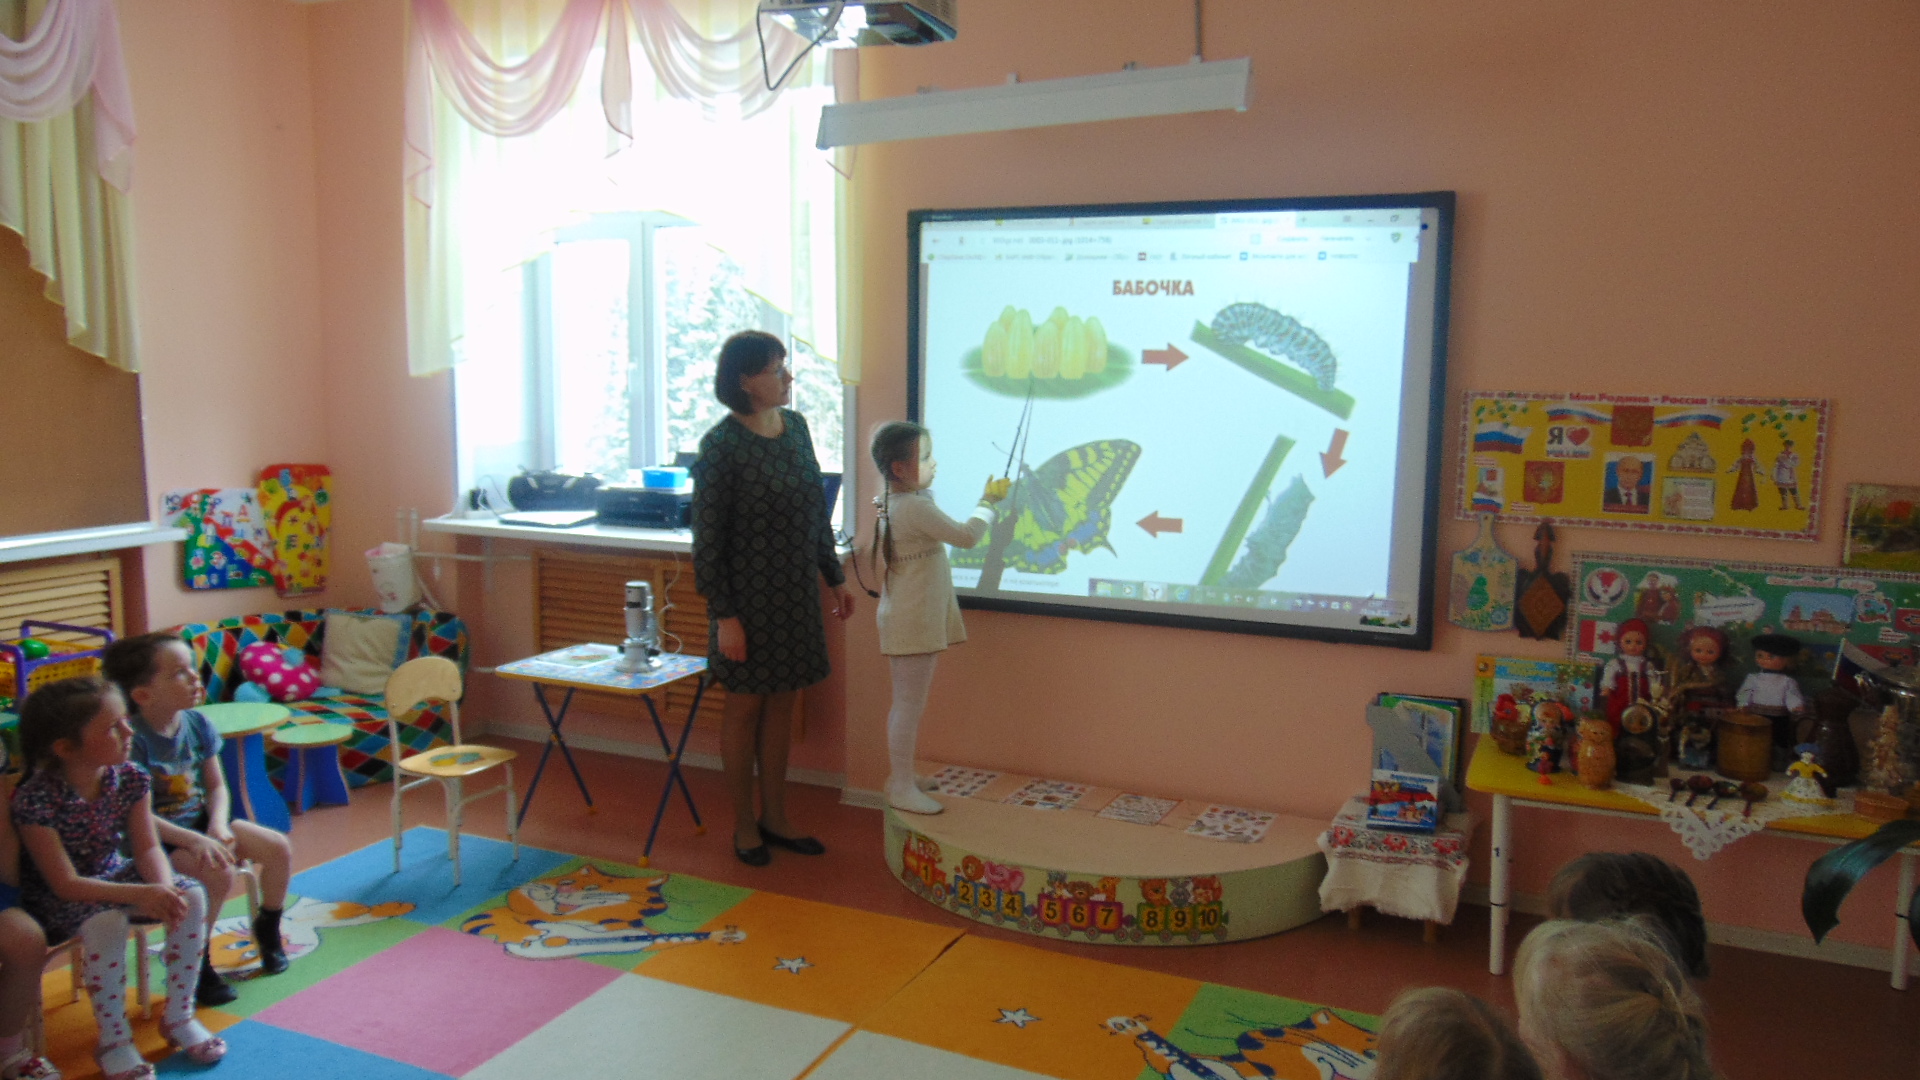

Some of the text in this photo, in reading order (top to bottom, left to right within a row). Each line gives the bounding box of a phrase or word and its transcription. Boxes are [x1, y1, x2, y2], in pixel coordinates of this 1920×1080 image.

[1113, 280, 1194, 295] БАБОЧКА
[1548, 427, 1563, 445] Я
[923, 865, 1218, 928] 1 2 3 4 5 6 7 8 9 10
